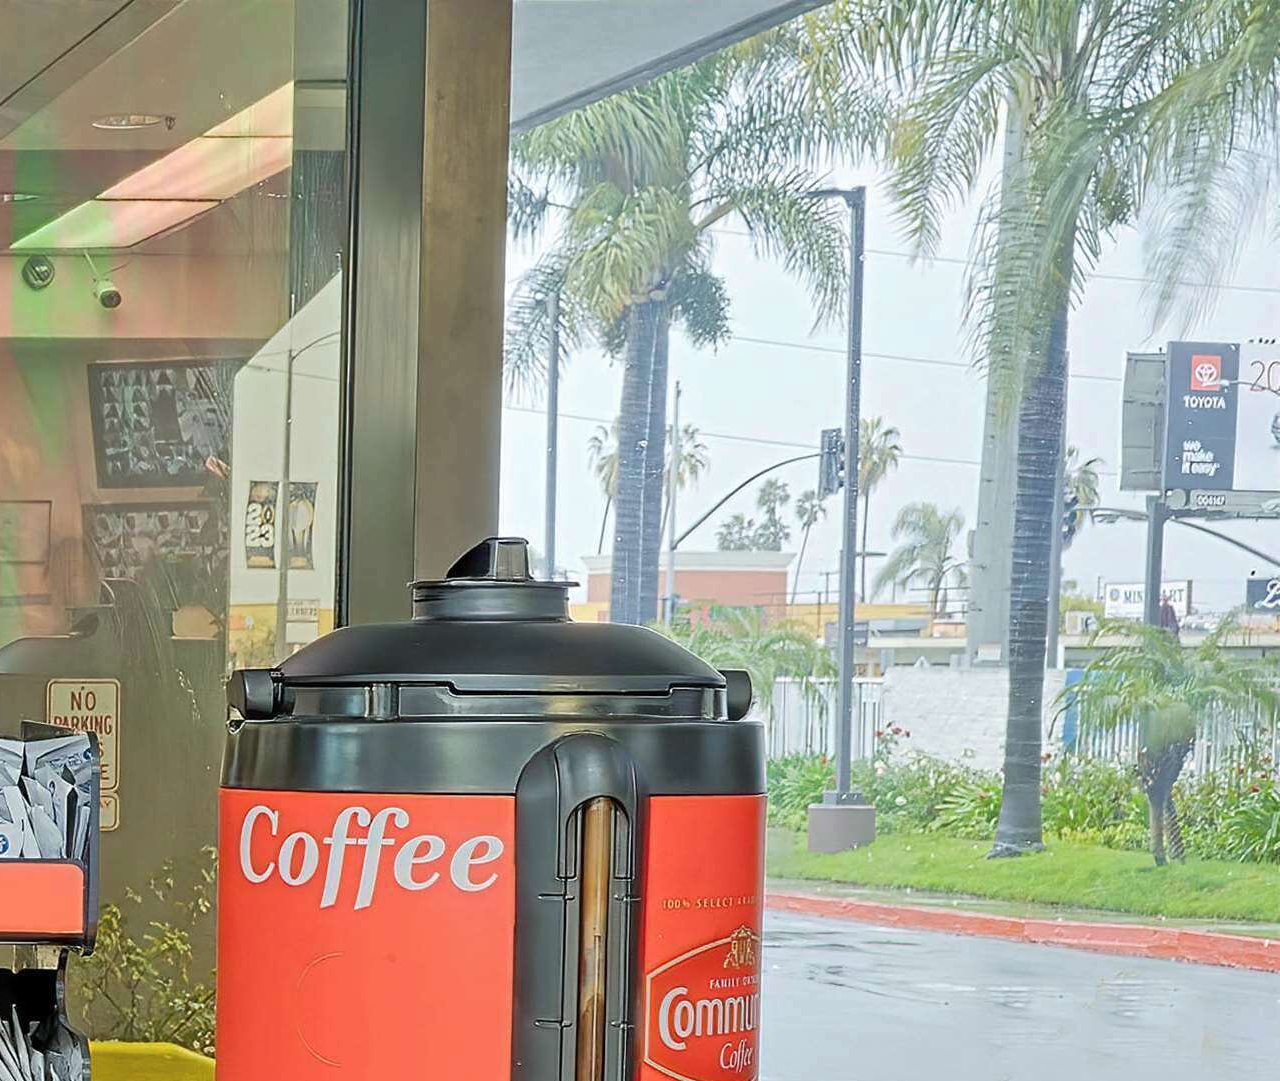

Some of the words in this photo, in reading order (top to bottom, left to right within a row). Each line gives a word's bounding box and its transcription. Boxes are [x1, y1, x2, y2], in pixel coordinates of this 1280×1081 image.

[1183, 395, 1226, 409] TOYOTA
[71, 691, 97, 711] NO
[53, 714, 113, 736] PARKING
[239, 805, 505, 910] Coffee
[695, 896, 734, 908] SELECT
